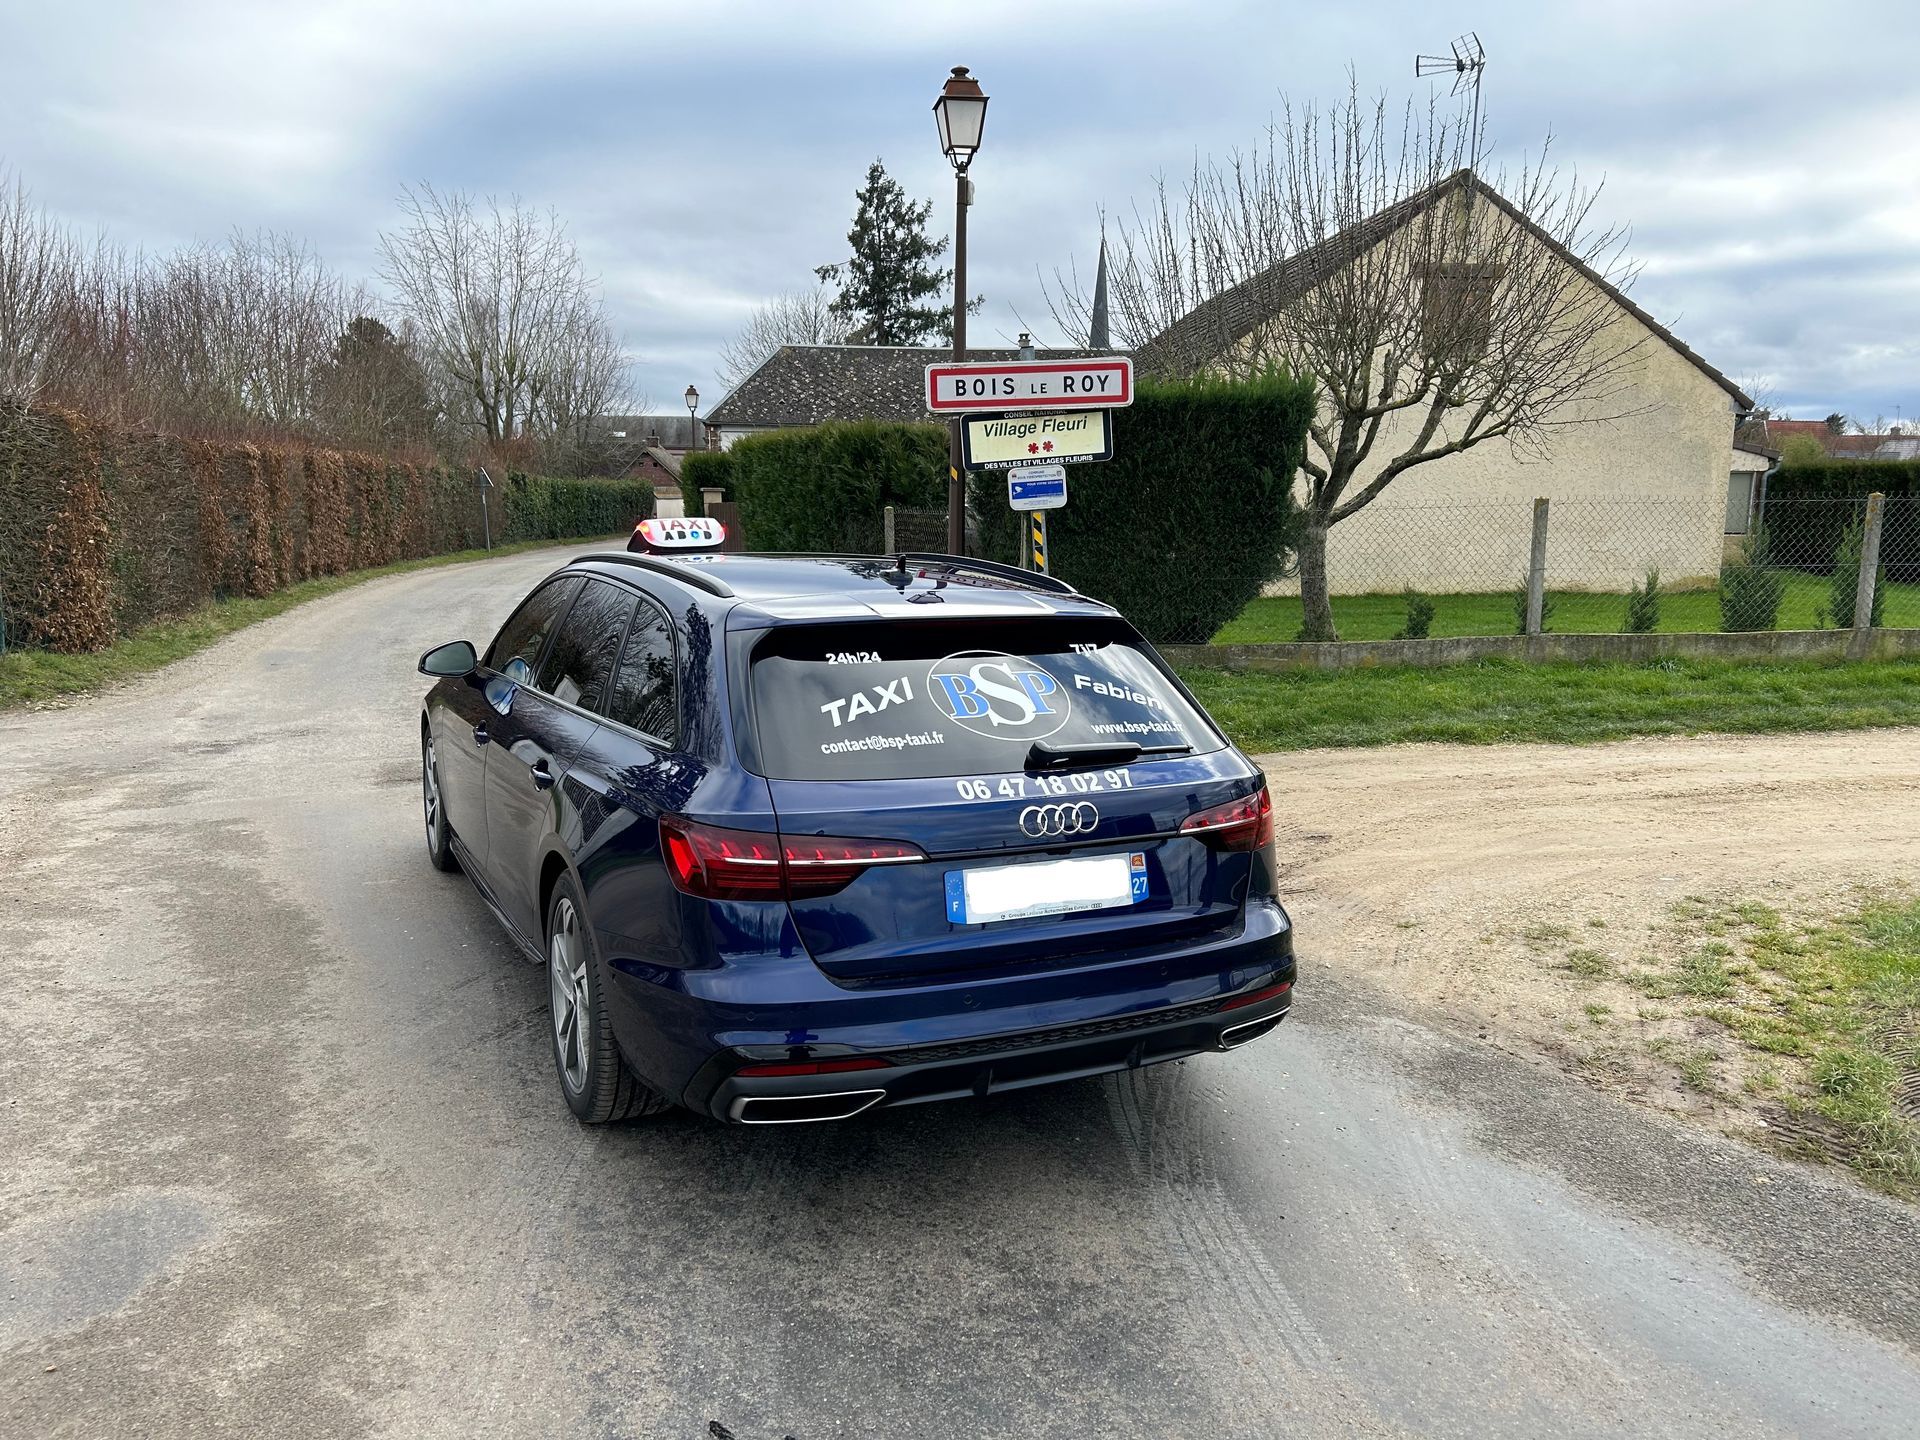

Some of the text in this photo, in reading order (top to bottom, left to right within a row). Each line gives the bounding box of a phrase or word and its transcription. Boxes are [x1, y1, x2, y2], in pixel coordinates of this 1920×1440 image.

[955, 374, 1110, 397] BOIS LE ROY
[1003, 410, 1034, 419] CONSEIL
[984, 415, 1088, 438] Village Fleuri
[998, 460, 1022, 468] VILLES
[1030, 457, 1065, 466] VILLAGES
[1065, 454, 1093, 463] FLEURIS
[659, 519, 711, 531] TAXI
[825, 651, 882, 665] 24h/24
[931, 662, 1057, 727] BSP
[1073, 673, 1163, 710] Fabien
[820, 676, 914, 728] TAXI
[1090, 720, 1184, 735] www.bsp-taxi.fr
[820, 730, 945, 754] contact@bsp-taxi.fr
[956, 768, 1133, 800] 06 47 18 02 97
[1132, 876, 1148, 894] 27
[952, 901, 959, 912] F
